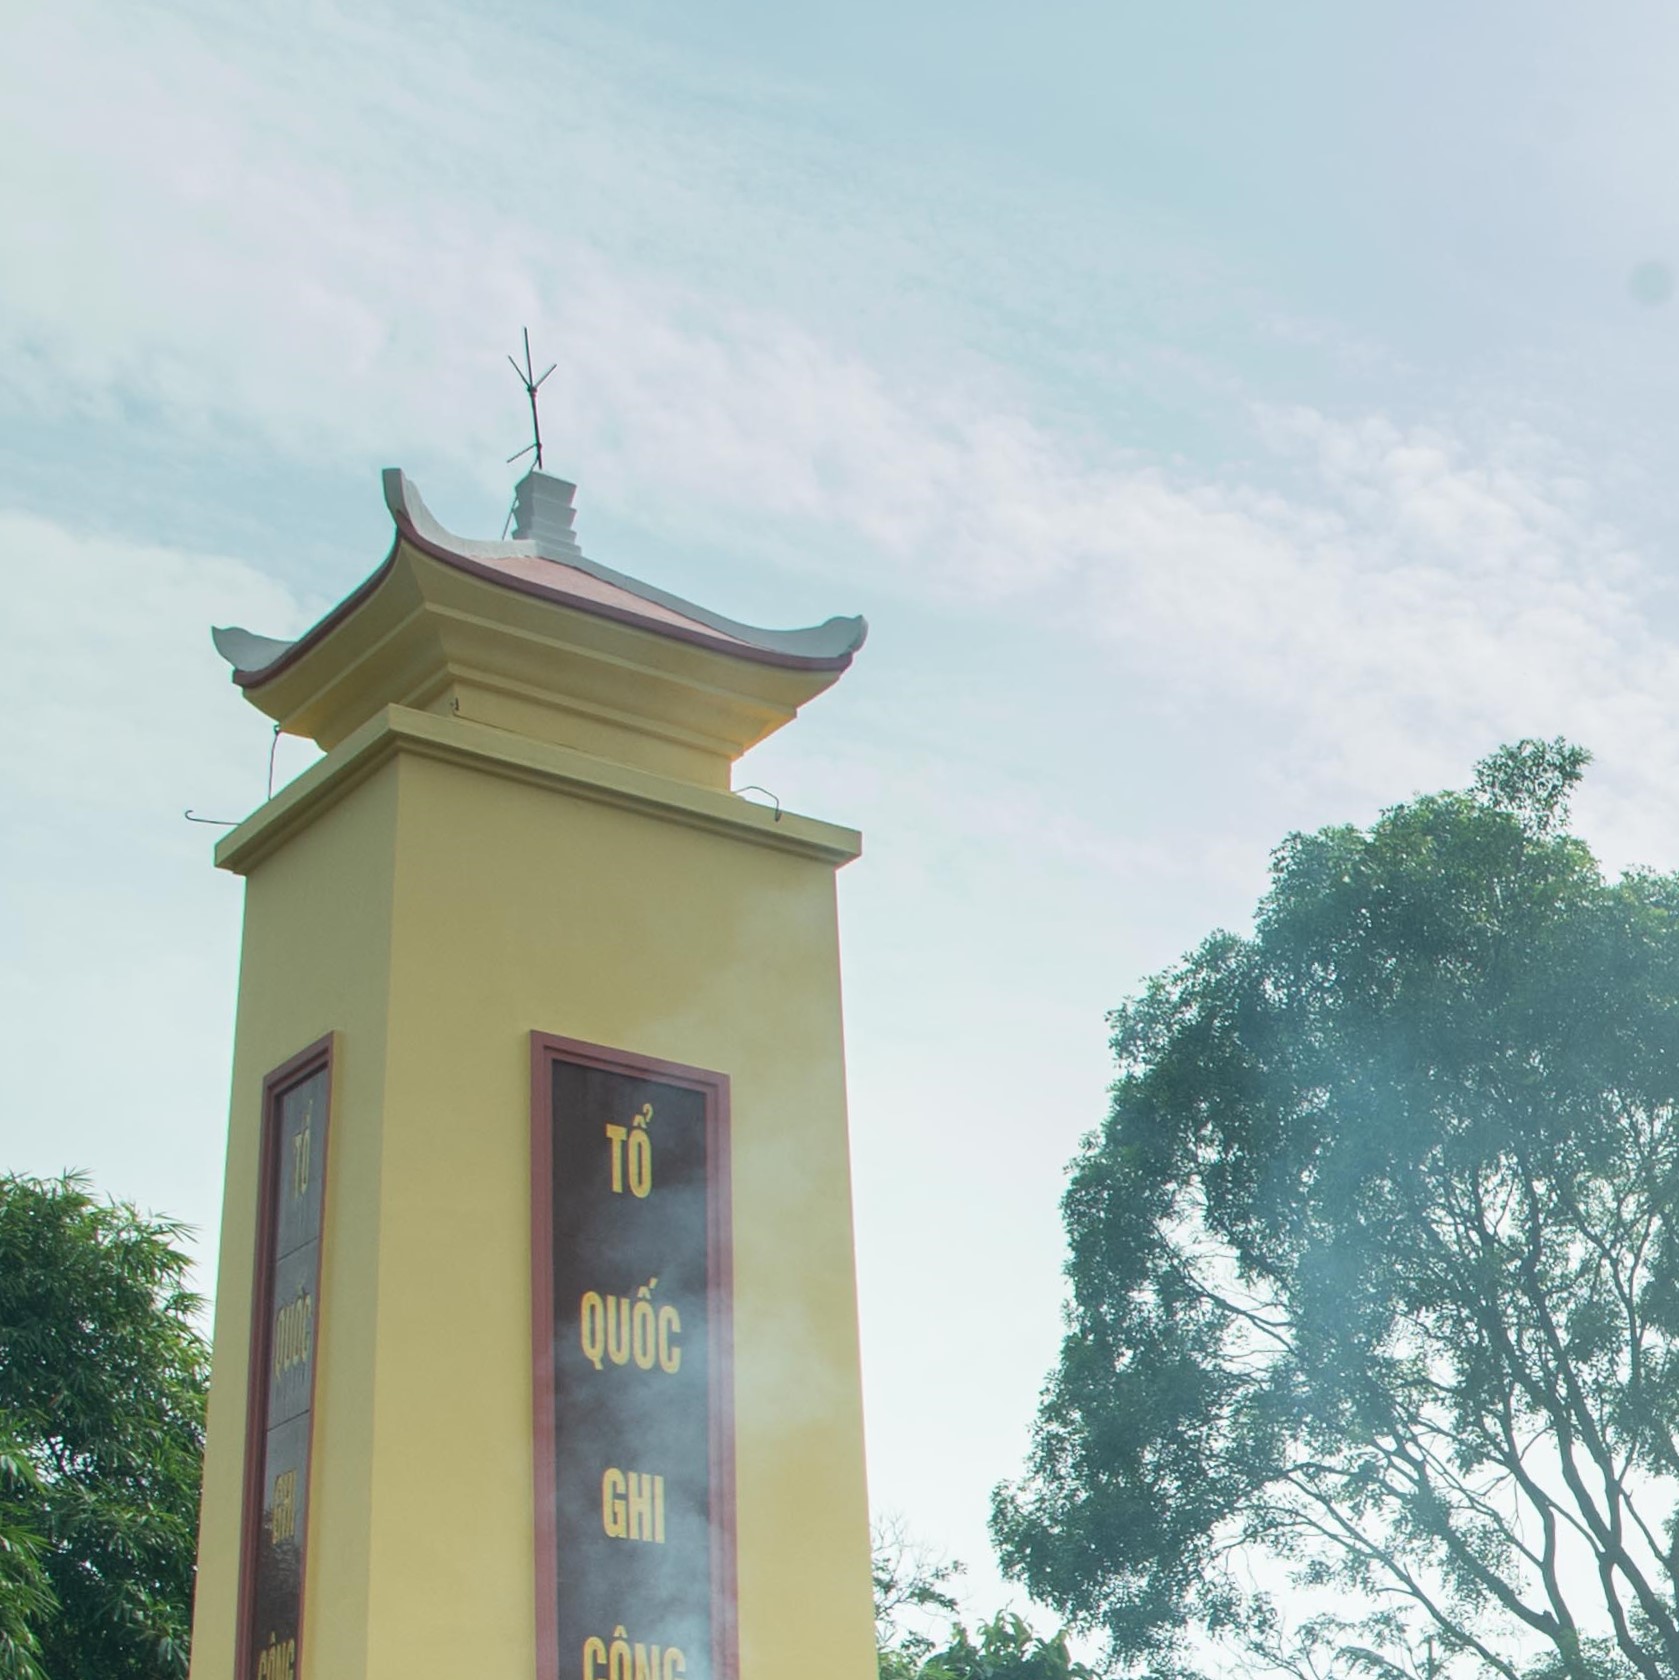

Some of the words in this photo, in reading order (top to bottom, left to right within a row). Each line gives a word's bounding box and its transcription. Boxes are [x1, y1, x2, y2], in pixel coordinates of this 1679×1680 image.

[606, 1103, 653, 1198] TỔ
[581, 1277, 681, 1374] QUỐC
[603, 1467, 665, 1543] GHI
